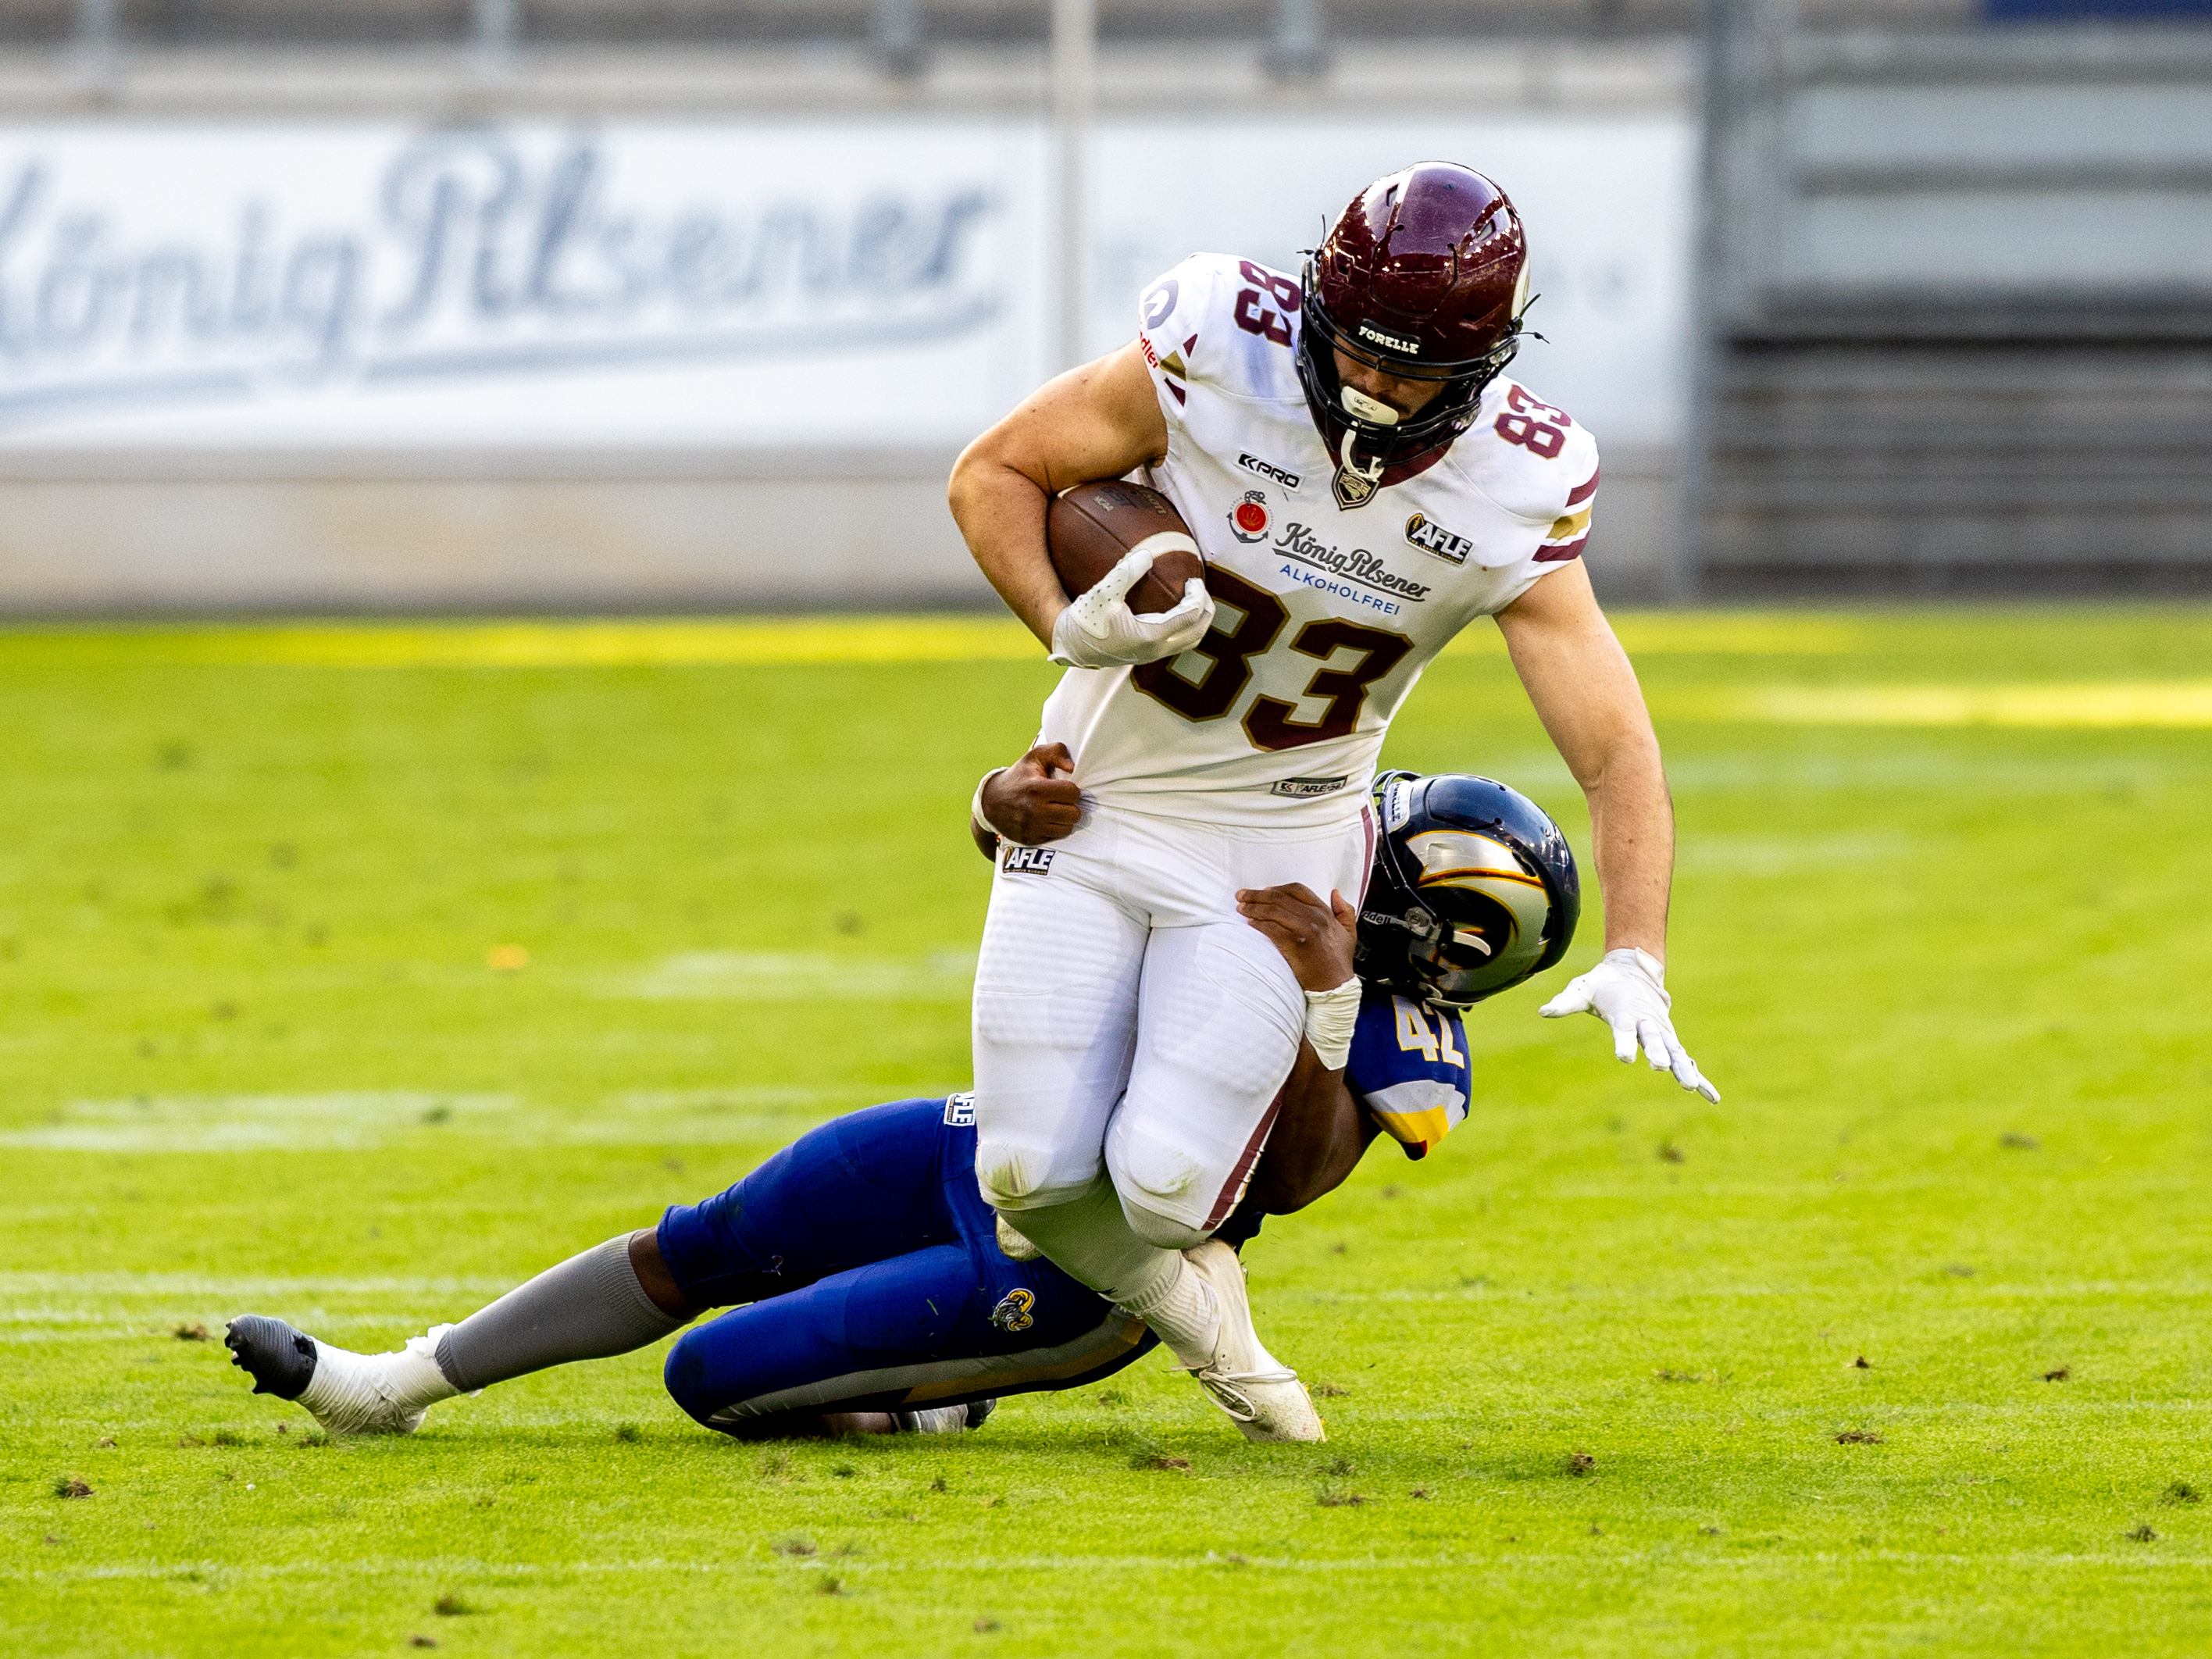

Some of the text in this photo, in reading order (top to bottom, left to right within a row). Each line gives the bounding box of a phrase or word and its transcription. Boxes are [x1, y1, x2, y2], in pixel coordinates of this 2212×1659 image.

[0, 155, 364, 395] önig
[1233, 260, 1301, 348] 83
[1359, 326, 1419, 355] FORELLE
[1493, 384, 1572, 460] 83
[1411, 521, 1472, 561] AFLE
[1279, 564, 1400, 615] ALKOHOLFREI
[1130, 560, 1415, 752] 83
[1004, 847, 1054, 870] AFLE
